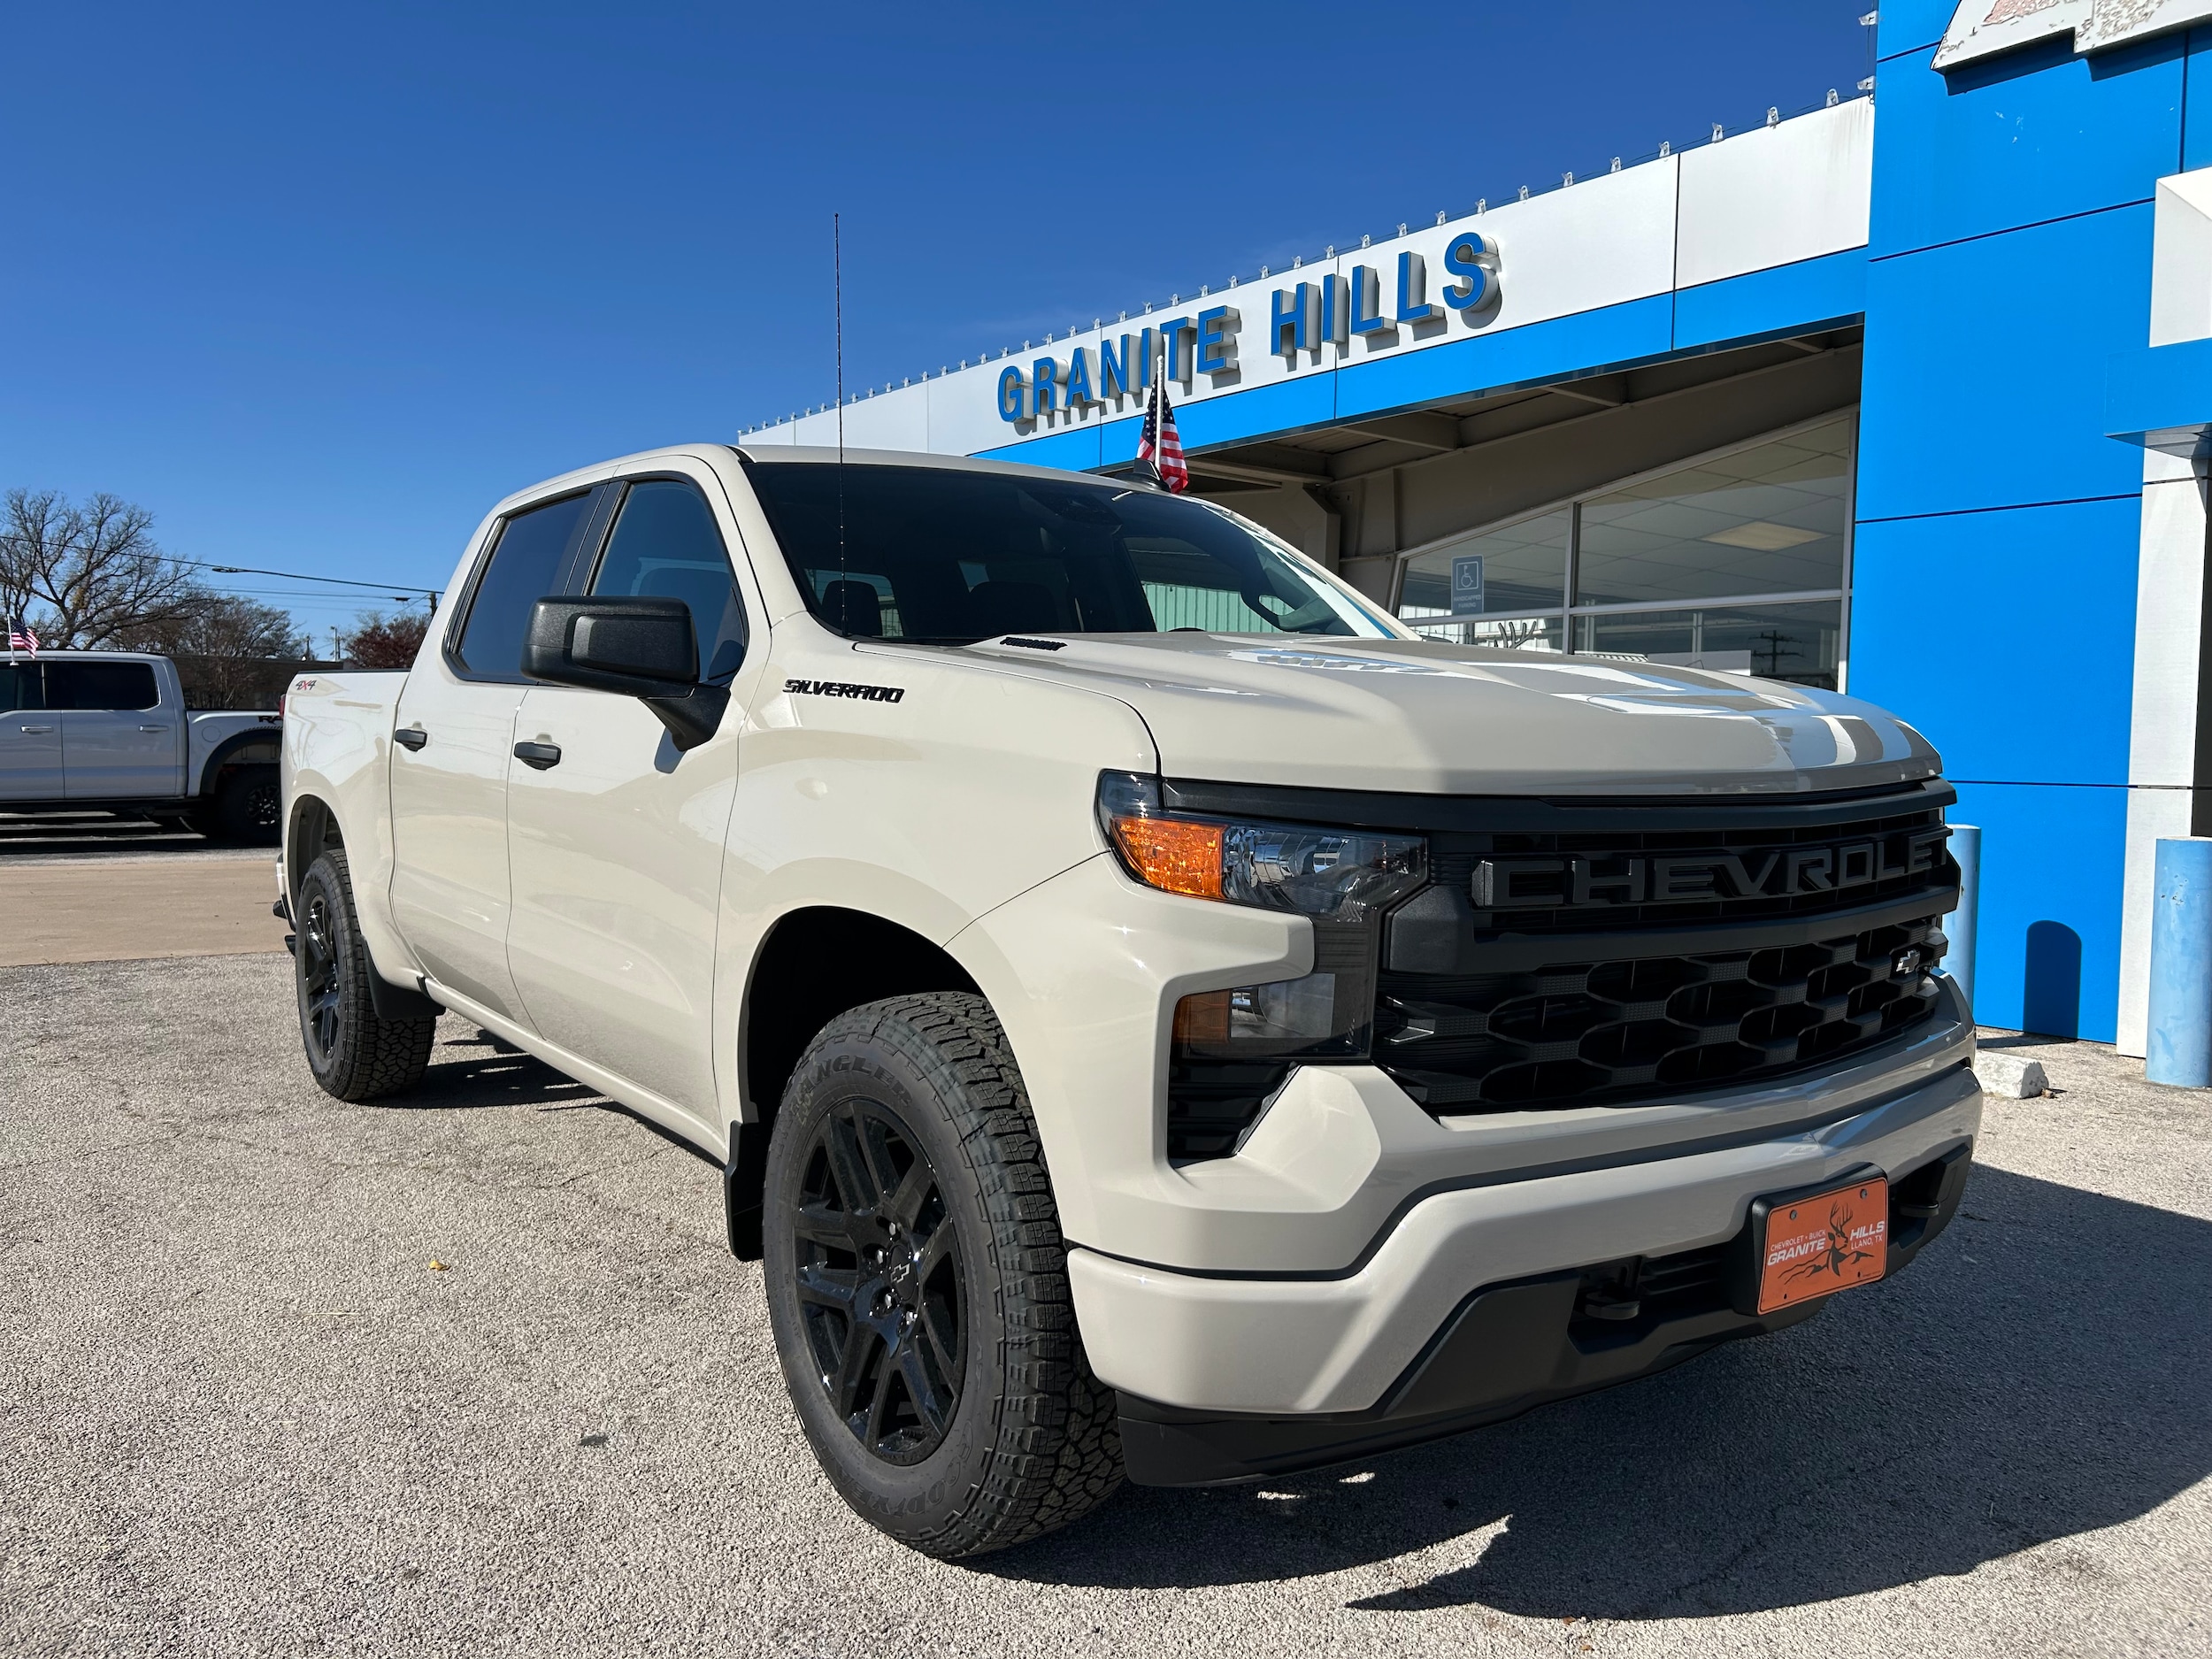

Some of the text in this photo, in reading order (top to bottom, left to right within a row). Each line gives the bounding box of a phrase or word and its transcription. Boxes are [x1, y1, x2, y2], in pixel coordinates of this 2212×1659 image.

[996, 231, 1497, 425] GRANITE HILLS
[782, 679, 904, 703] SILVERADO
[1474, 827, 1953, 908] CHEVROLET
[1768, 1220, 1885, 1266] GRANITE HILLS
[1770, 1230, 1826, 1252] CHEVROLET BUICK
[1875, 1234, 1883, 1243] TX
[814, 1419, 974, 1518] GOODYEAR
